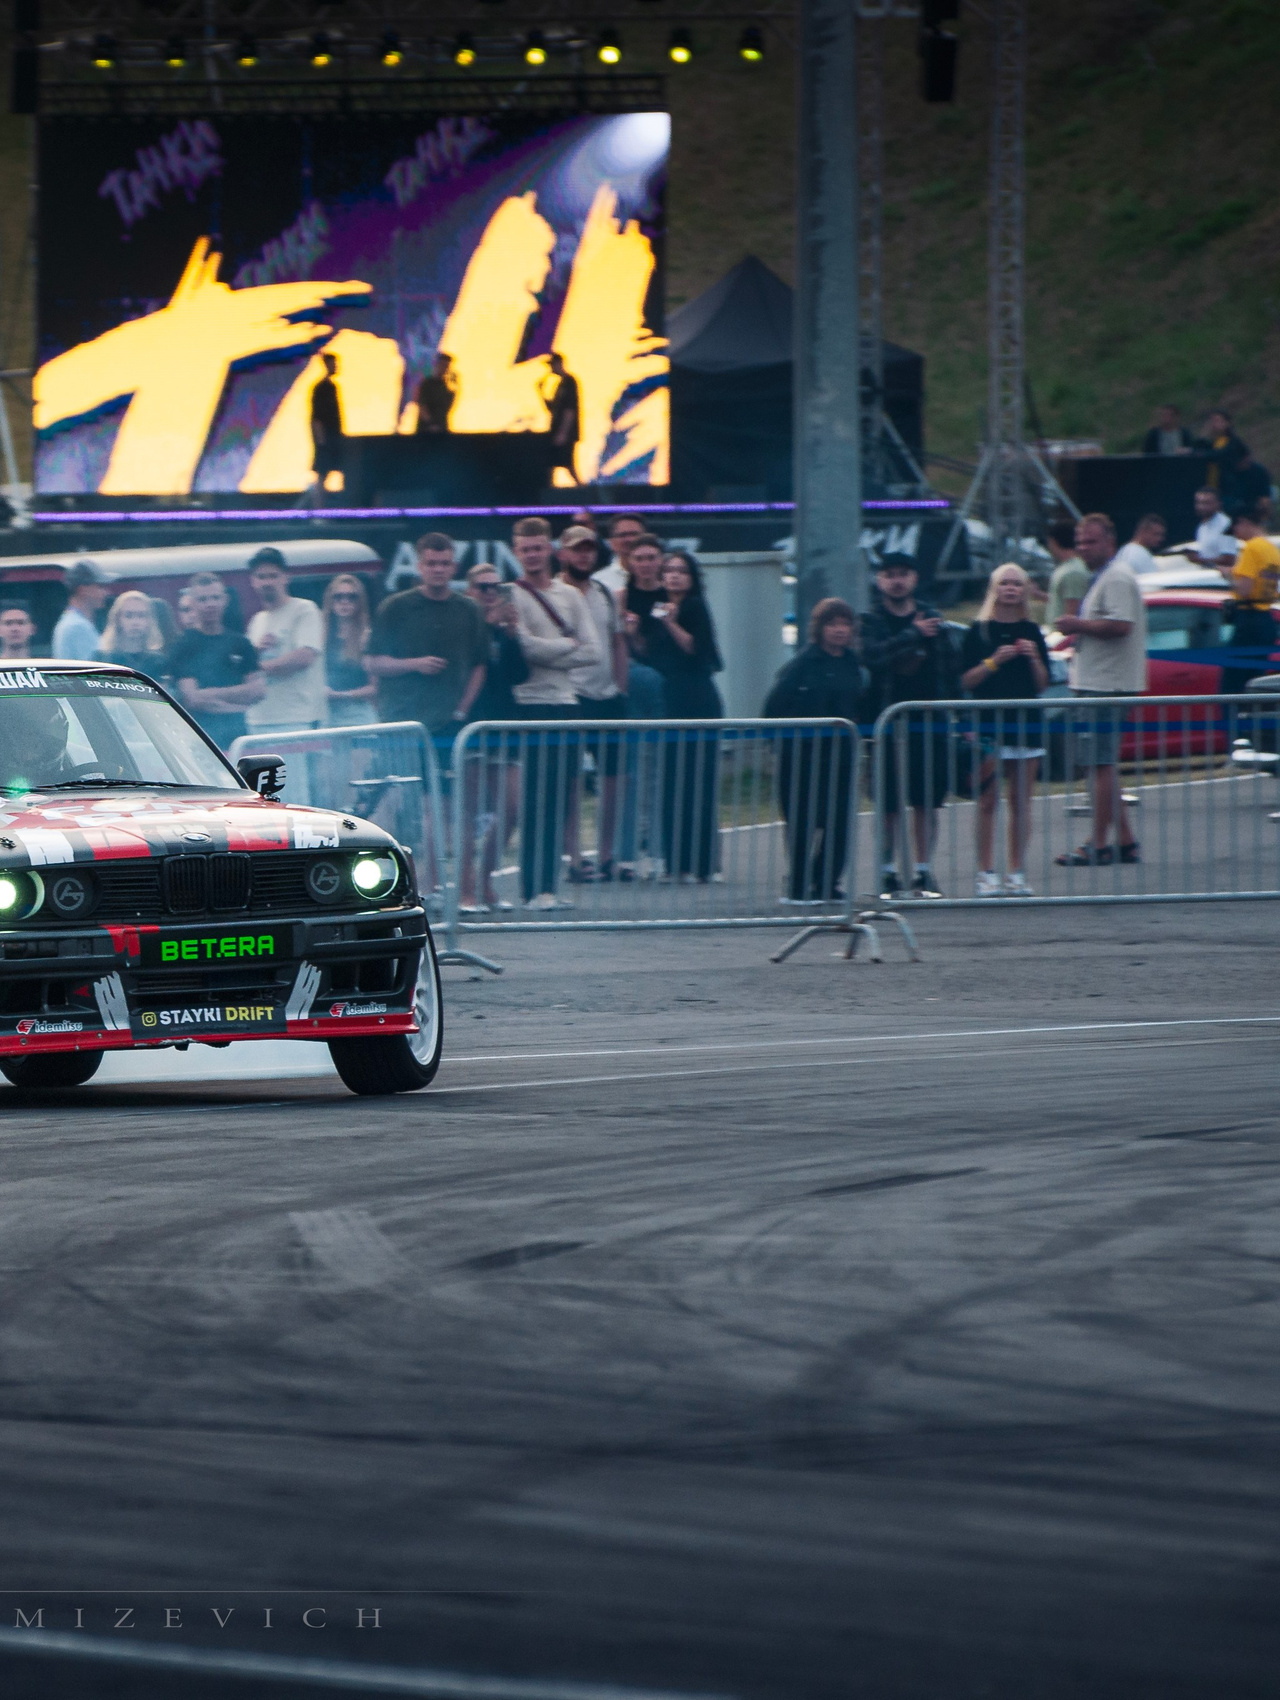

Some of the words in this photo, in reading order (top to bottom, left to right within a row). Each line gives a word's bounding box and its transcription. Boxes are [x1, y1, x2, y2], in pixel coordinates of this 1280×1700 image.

[346, 1001, 387, 1015] idemitsu
[160, 1007, 222, 1025] STAYKI
[225, 1006, 274, 1021] DRIFT
[35, 1019, 83, 1033] idemitsu
